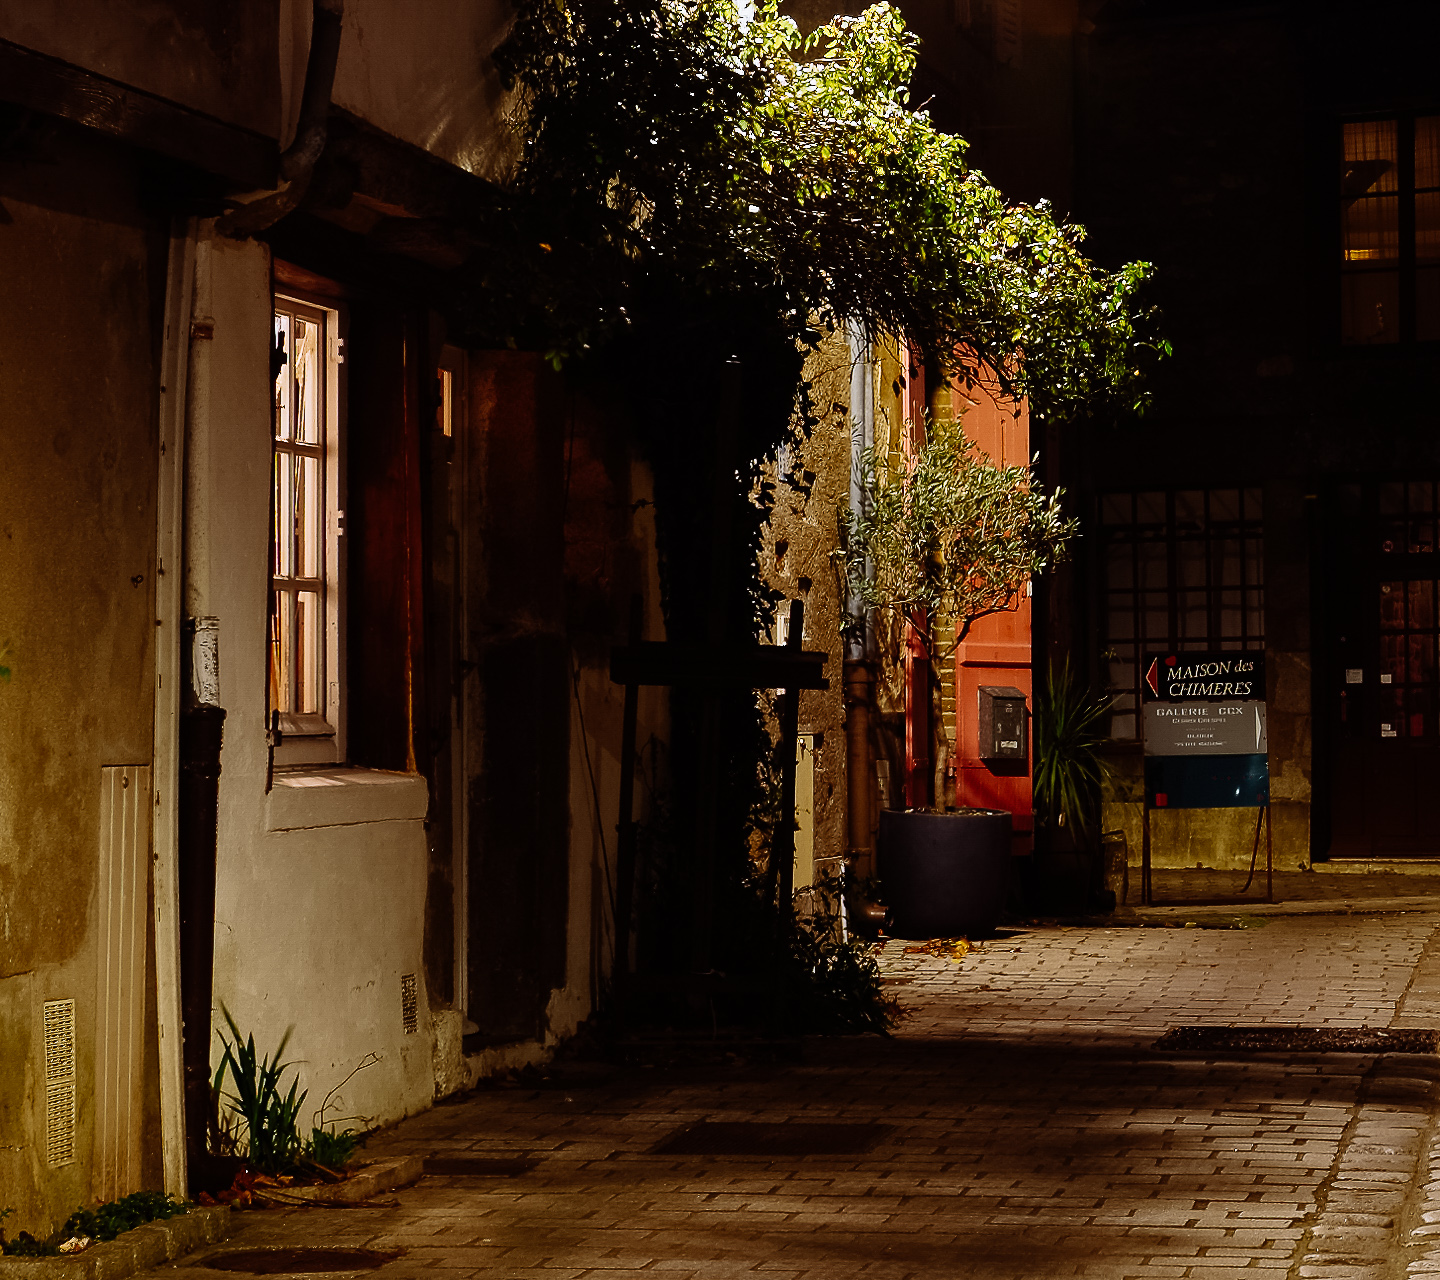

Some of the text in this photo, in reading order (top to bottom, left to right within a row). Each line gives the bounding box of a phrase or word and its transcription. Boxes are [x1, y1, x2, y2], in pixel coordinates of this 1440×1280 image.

[1167, 659, 1253, 681] MAISON des
[1169, 681, 1253, 696] CHIMERES
[1156, 708, 1209, 717] GALERIE
